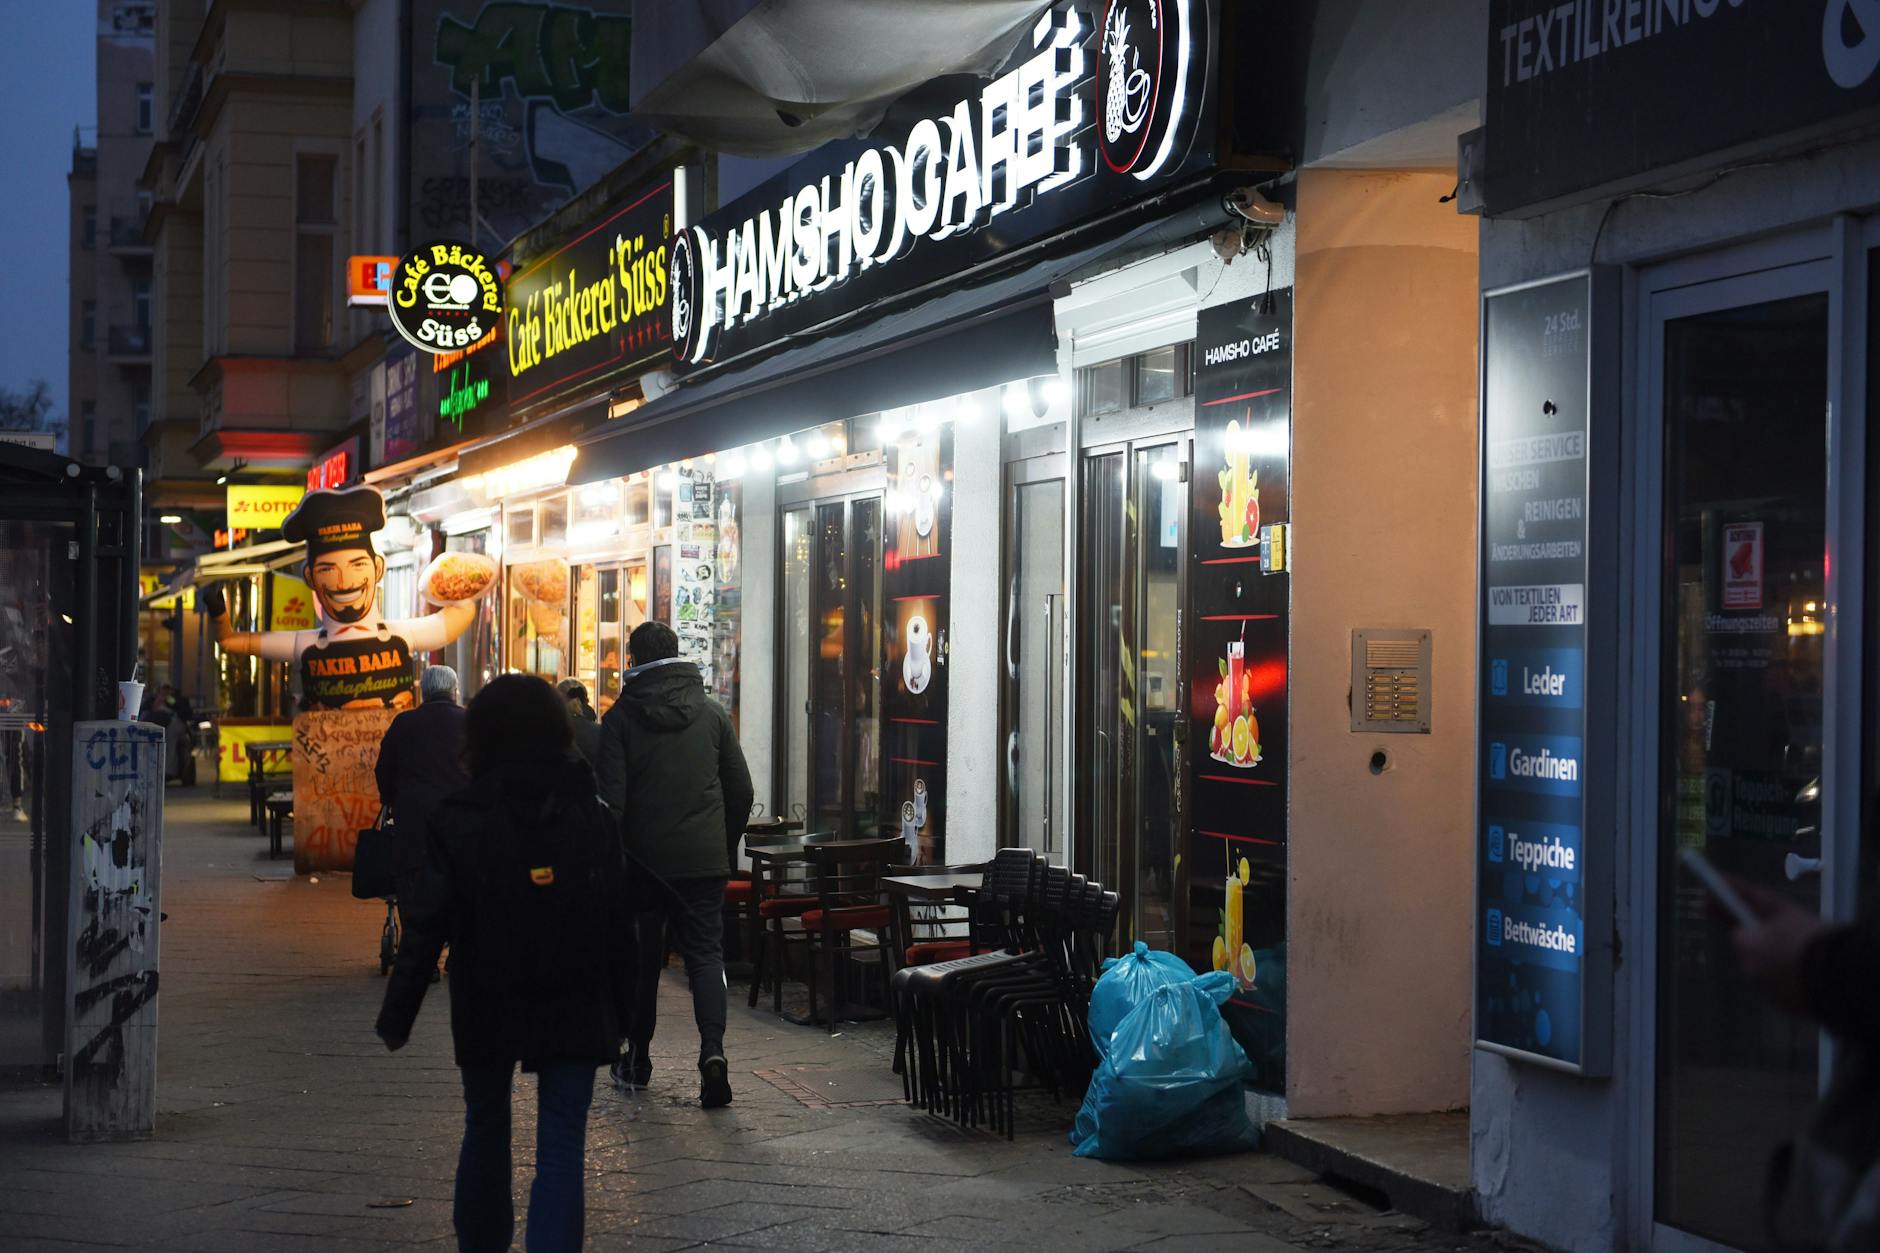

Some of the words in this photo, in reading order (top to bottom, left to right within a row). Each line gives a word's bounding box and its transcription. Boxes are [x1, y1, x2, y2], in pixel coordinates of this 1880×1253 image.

[706, 147, 904, 332] HAMSHO
[905, 4, 1083, 240] CAFÉ
[397, 255, 435, 308] Café
[435, 243, 503, 314] Bäckerei
[508, 290, 540, 377] Café
[543, 248, 617, 358] Bäckerei
[619, 233, 667, 323] Süss
[417, 317, 483, 348] Süss
[1205, 340, 1250, 366] HAMSHO
[1252, 328, 1280, 355] CAFÉ
[1530, 435, 1581, 461] SERVICE
[253, 502, 298, 513] LOTTO
[1524, 498, 1581, 523] REINIGEN
[1492, 588, 1515, 606] VON
[1515, 586, 1562, 606] TEXTILIEN
[276, 617, 310, 627] LOTTO
[1528, 604, 1557, 623] JEDER
[1558, 603, 1579, 622] ART
[308, 656, 357, 677] FAKIR
[359, 649, 402, 674] BABA
[1523, 666, 1565, 697] Leder
[1510, 747, 1578, 782] Gardinen
[1508, 832, 1575, 873] Teppiche
[1504, 916, 1576, 954] Bettwäsche
